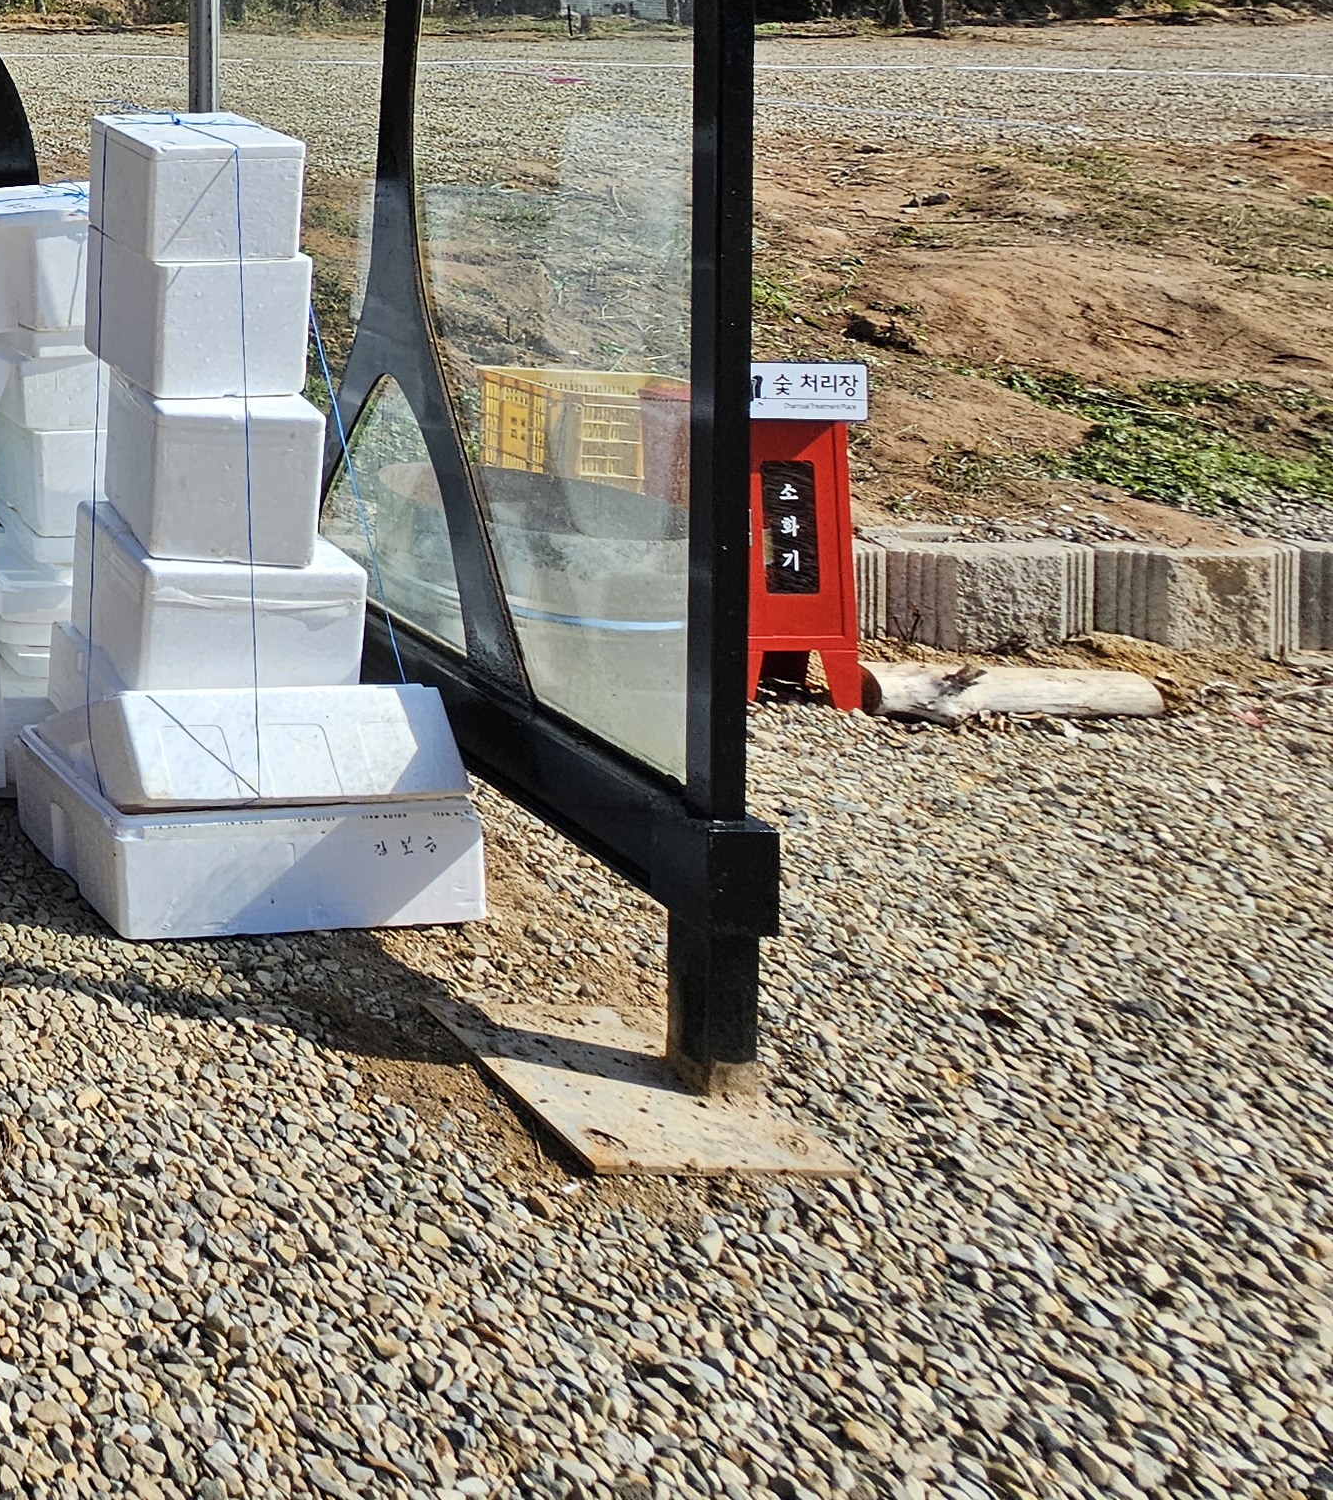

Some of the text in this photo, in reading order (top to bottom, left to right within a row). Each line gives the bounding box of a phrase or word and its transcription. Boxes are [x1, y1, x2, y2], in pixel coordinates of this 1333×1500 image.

[772, 374, 859, 397] 숯 처리장
[779, 483, 800, 572] 소화기
